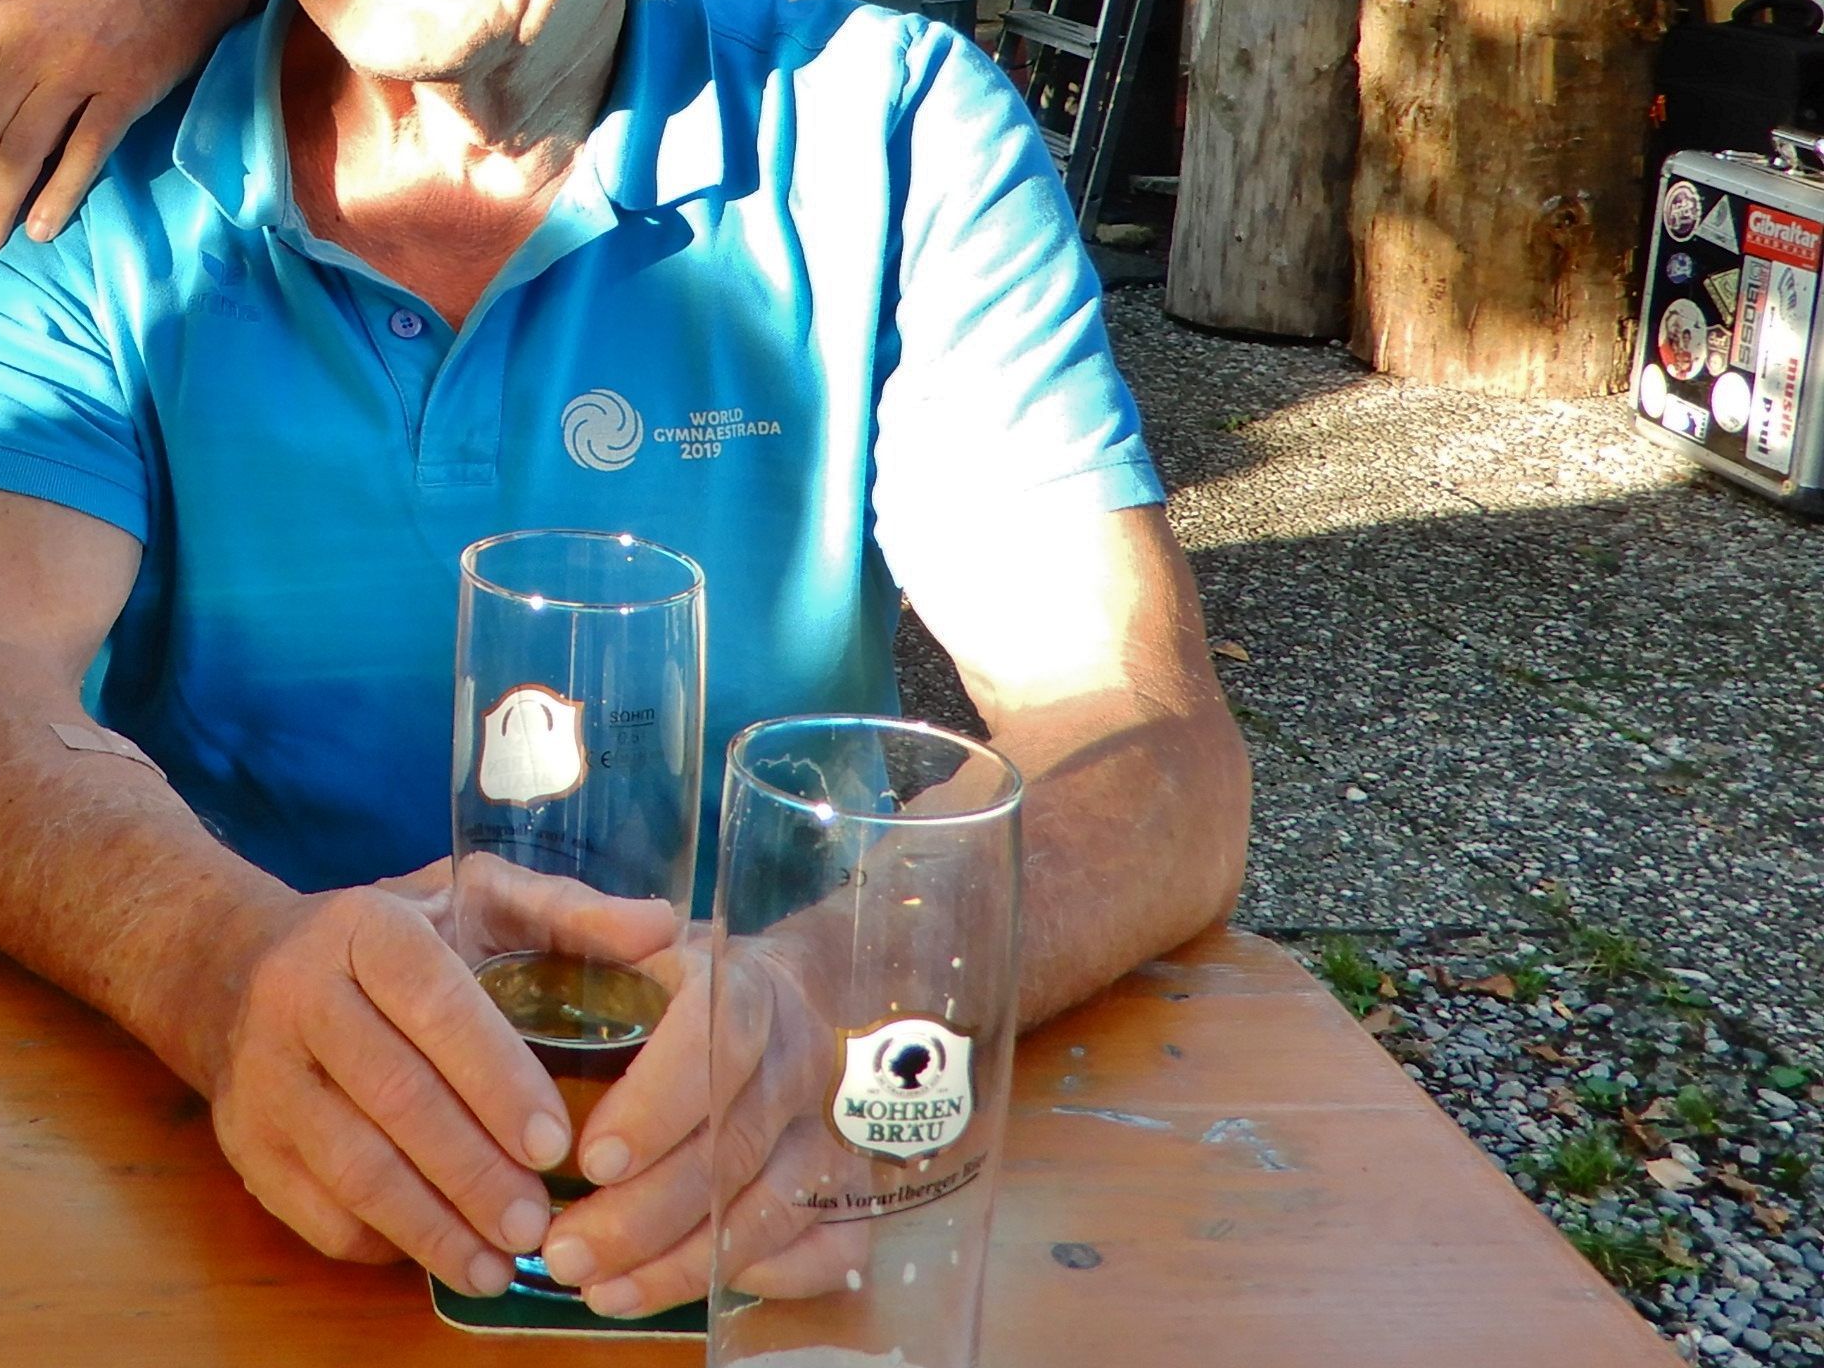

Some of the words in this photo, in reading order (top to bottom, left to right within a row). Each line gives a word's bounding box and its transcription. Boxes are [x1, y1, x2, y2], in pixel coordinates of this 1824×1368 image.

[1748, 211, 1819, 248] Gibraltar
[1738, 283, 1760, 365] BOSS
[689, 408, 743, 426] WORLD
[653, 421, 782, 443] GYMNAESTRADA
[680, 442, 722, 460] 2019
[845, 1096, 964, 1121] MOHREN
[866, 1122, 944, 1143] BRÄU
[845, 1172, 959, 1209] Vorarlberger
